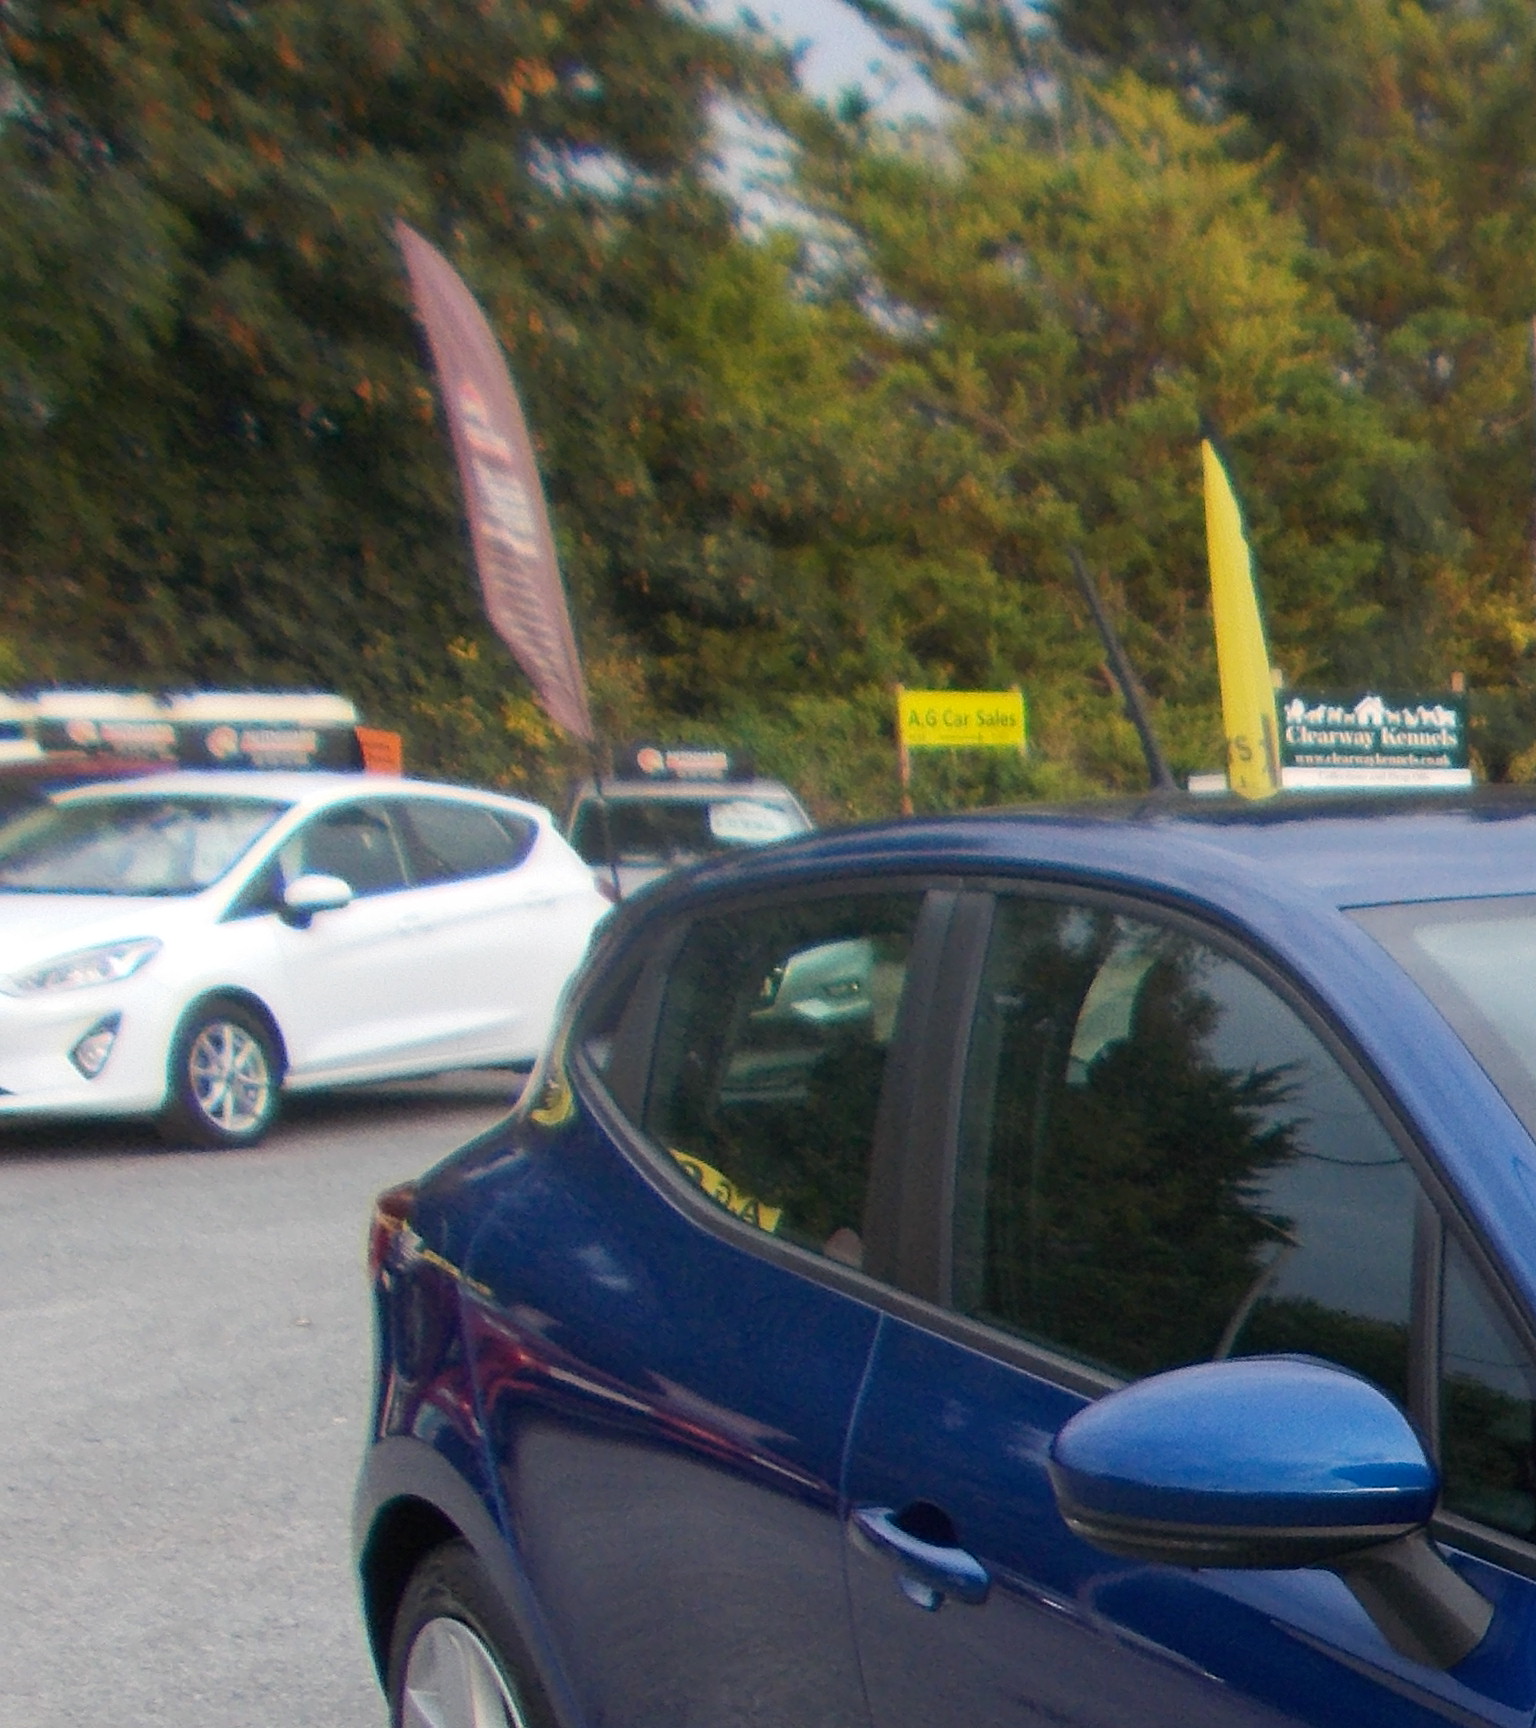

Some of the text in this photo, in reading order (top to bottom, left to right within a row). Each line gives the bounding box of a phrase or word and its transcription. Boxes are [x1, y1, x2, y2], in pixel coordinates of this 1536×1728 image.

[975, 709, 1017, 728] Sales
[1285, 725, 1458, 750] Clearway Kennels
